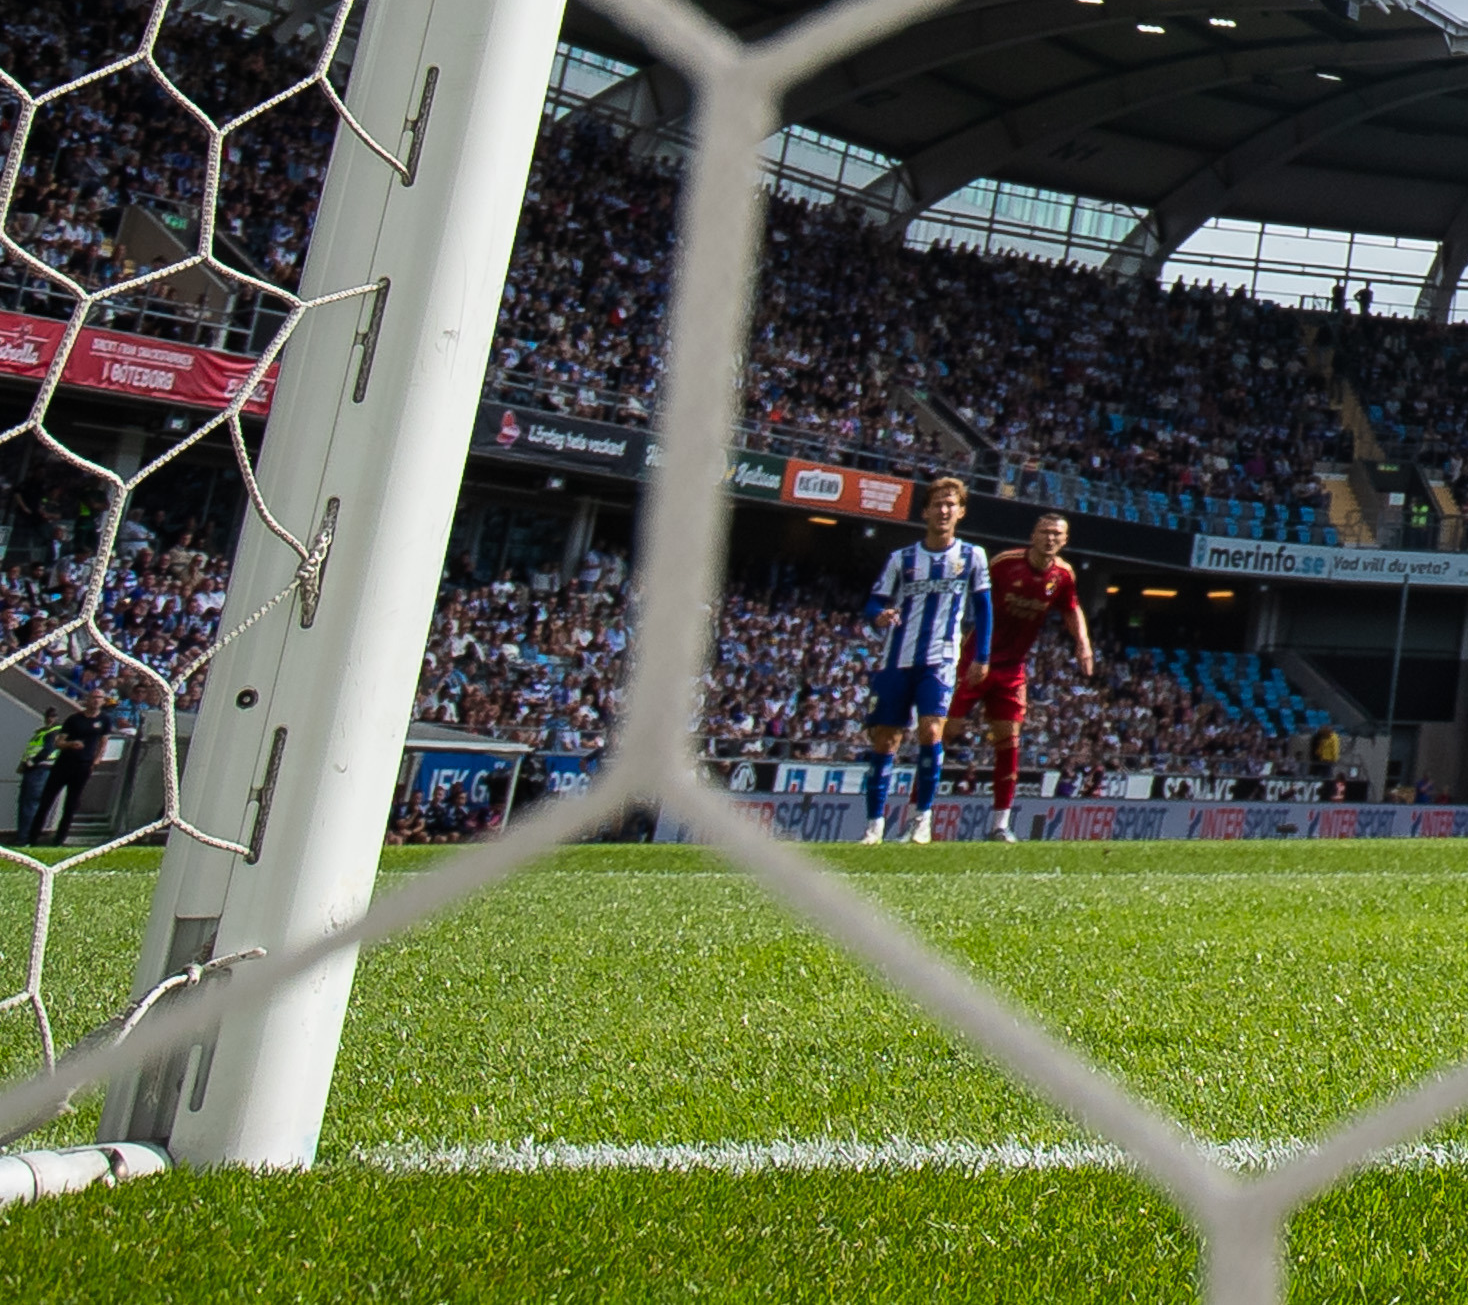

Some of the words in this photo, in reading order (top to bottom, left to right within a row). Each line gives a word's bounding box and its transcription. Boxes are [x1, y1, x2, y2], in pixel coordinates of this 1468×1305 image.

[1208, 544, 1326, 575] merinfo.se
[1333, 555, 1359, 571] Vad
[1362, 556, 1385, 572] vill
[1387, 558, 1409, 574] du
[1409, 560, 1450, 576] veta?
[1060, 805, 1167, 841] INTERSPORT
[1199, 806, 1290, 840] INTERSPORT
[1318, 807, 1397, 839] INTERSPORT
